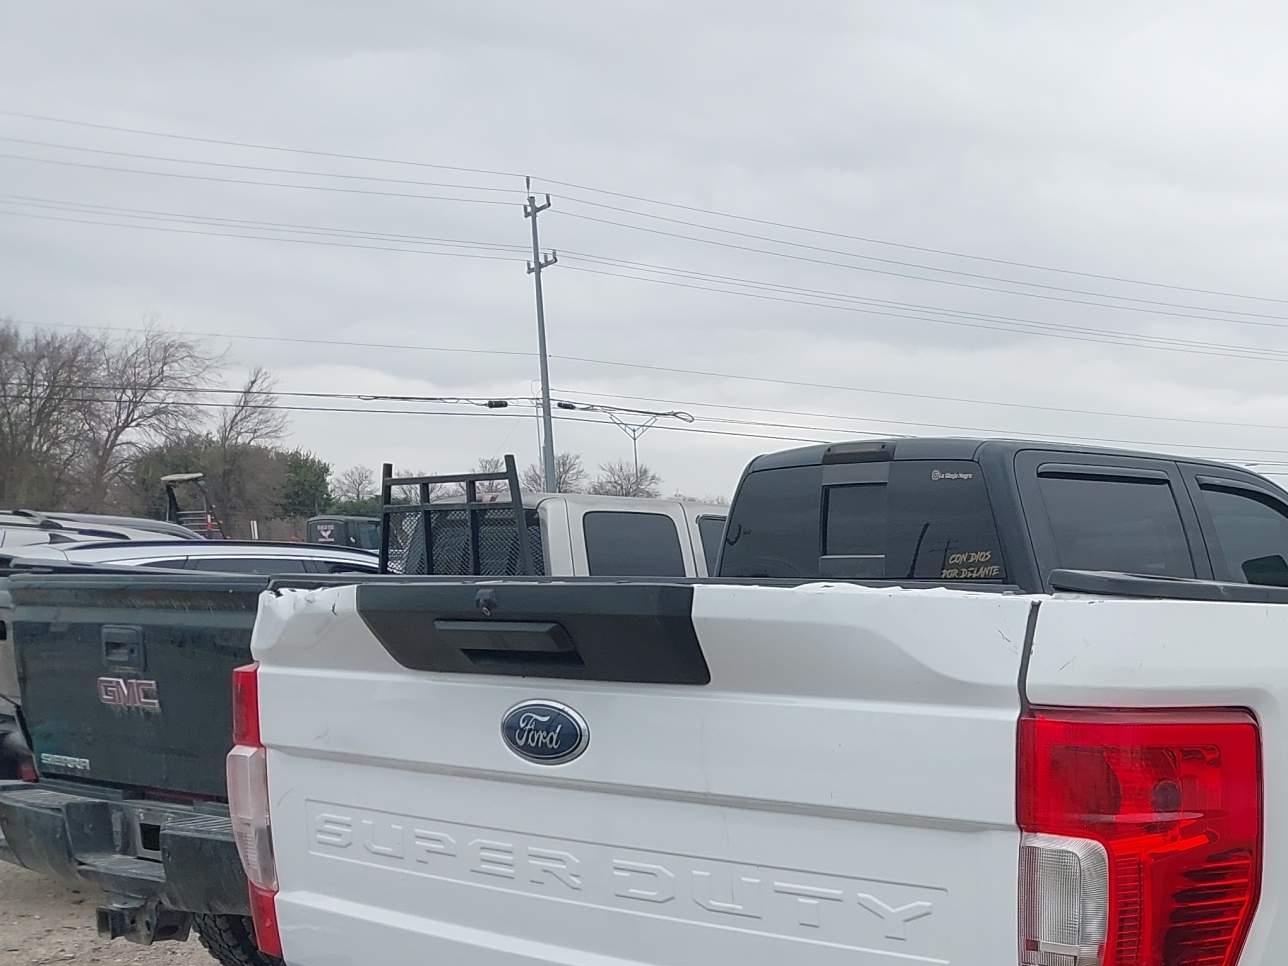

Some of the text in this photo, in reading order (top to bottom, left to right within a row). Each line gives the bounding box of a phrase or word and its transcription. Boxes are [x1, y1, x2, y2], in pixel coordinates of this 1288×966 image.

[949, 550, 992, 565] CON DIOS
[959, 565, 1000, 578] DELANTE
[97, 676, 161, 708] GMC
[515, 712, 562, 749] Ford
[40, 753, 91, 771] SIERRA
[314, 812, 933, 942] SUPER DUTY
